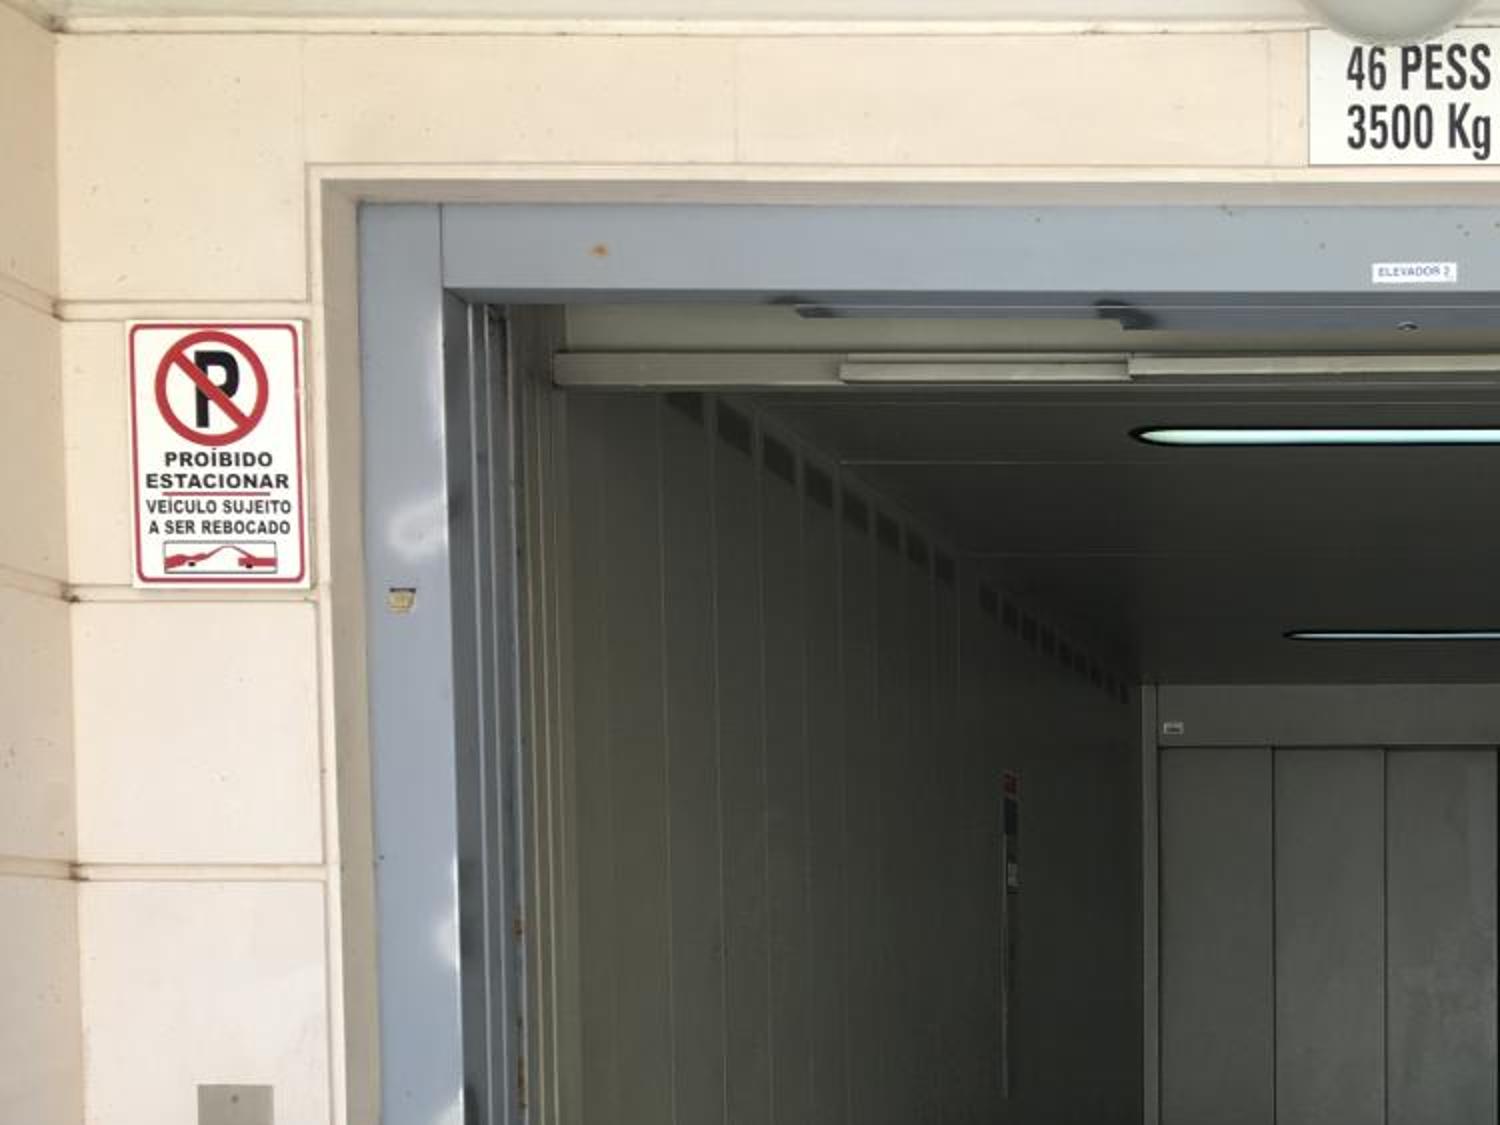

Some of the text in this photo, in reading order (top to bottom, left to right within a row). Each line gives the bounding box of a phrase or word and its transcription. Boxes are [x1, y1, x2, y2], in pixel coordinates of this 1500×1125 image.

[1346, 43, 1492, 91] 46 PESS
[1346, 102, 1492, 161] 3500 Kg
[145, 473, 289, 488] ESTACIONAR
[222, 499, 292, 514] SUJEITO
[148, 519, 291, 535] A SER REBOCADO
